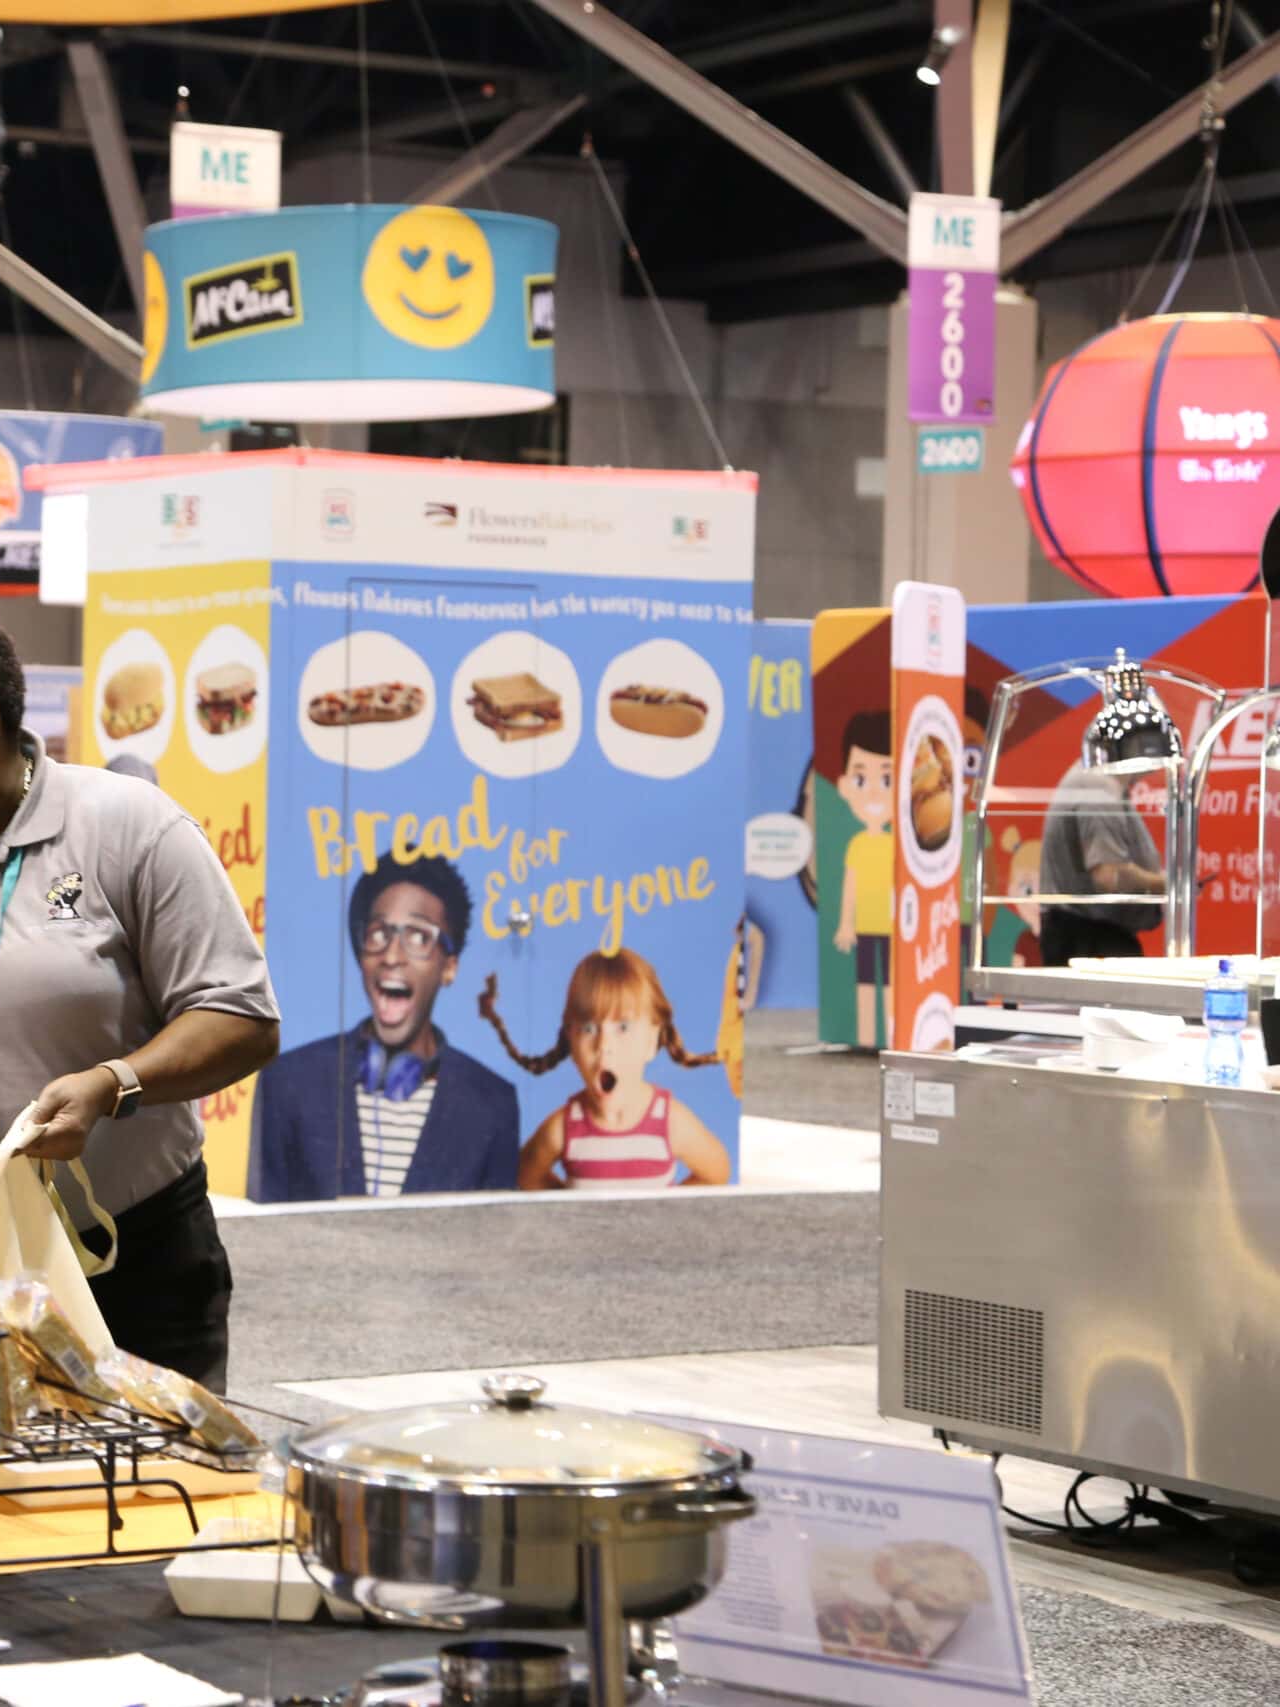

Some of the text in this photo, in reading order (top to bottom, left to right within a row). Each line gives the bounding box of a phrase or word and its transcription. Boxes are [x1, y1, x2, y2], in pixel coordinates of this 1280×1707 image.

[200, 149, 251, 184] ME
[933, 216, 977, 248] ME
[940, 271, 965, 418] 2600
[308, 774, 507, 879] Bread
[509, 828, 568, 883] for
[481, 857, 716, 958] Everyone
